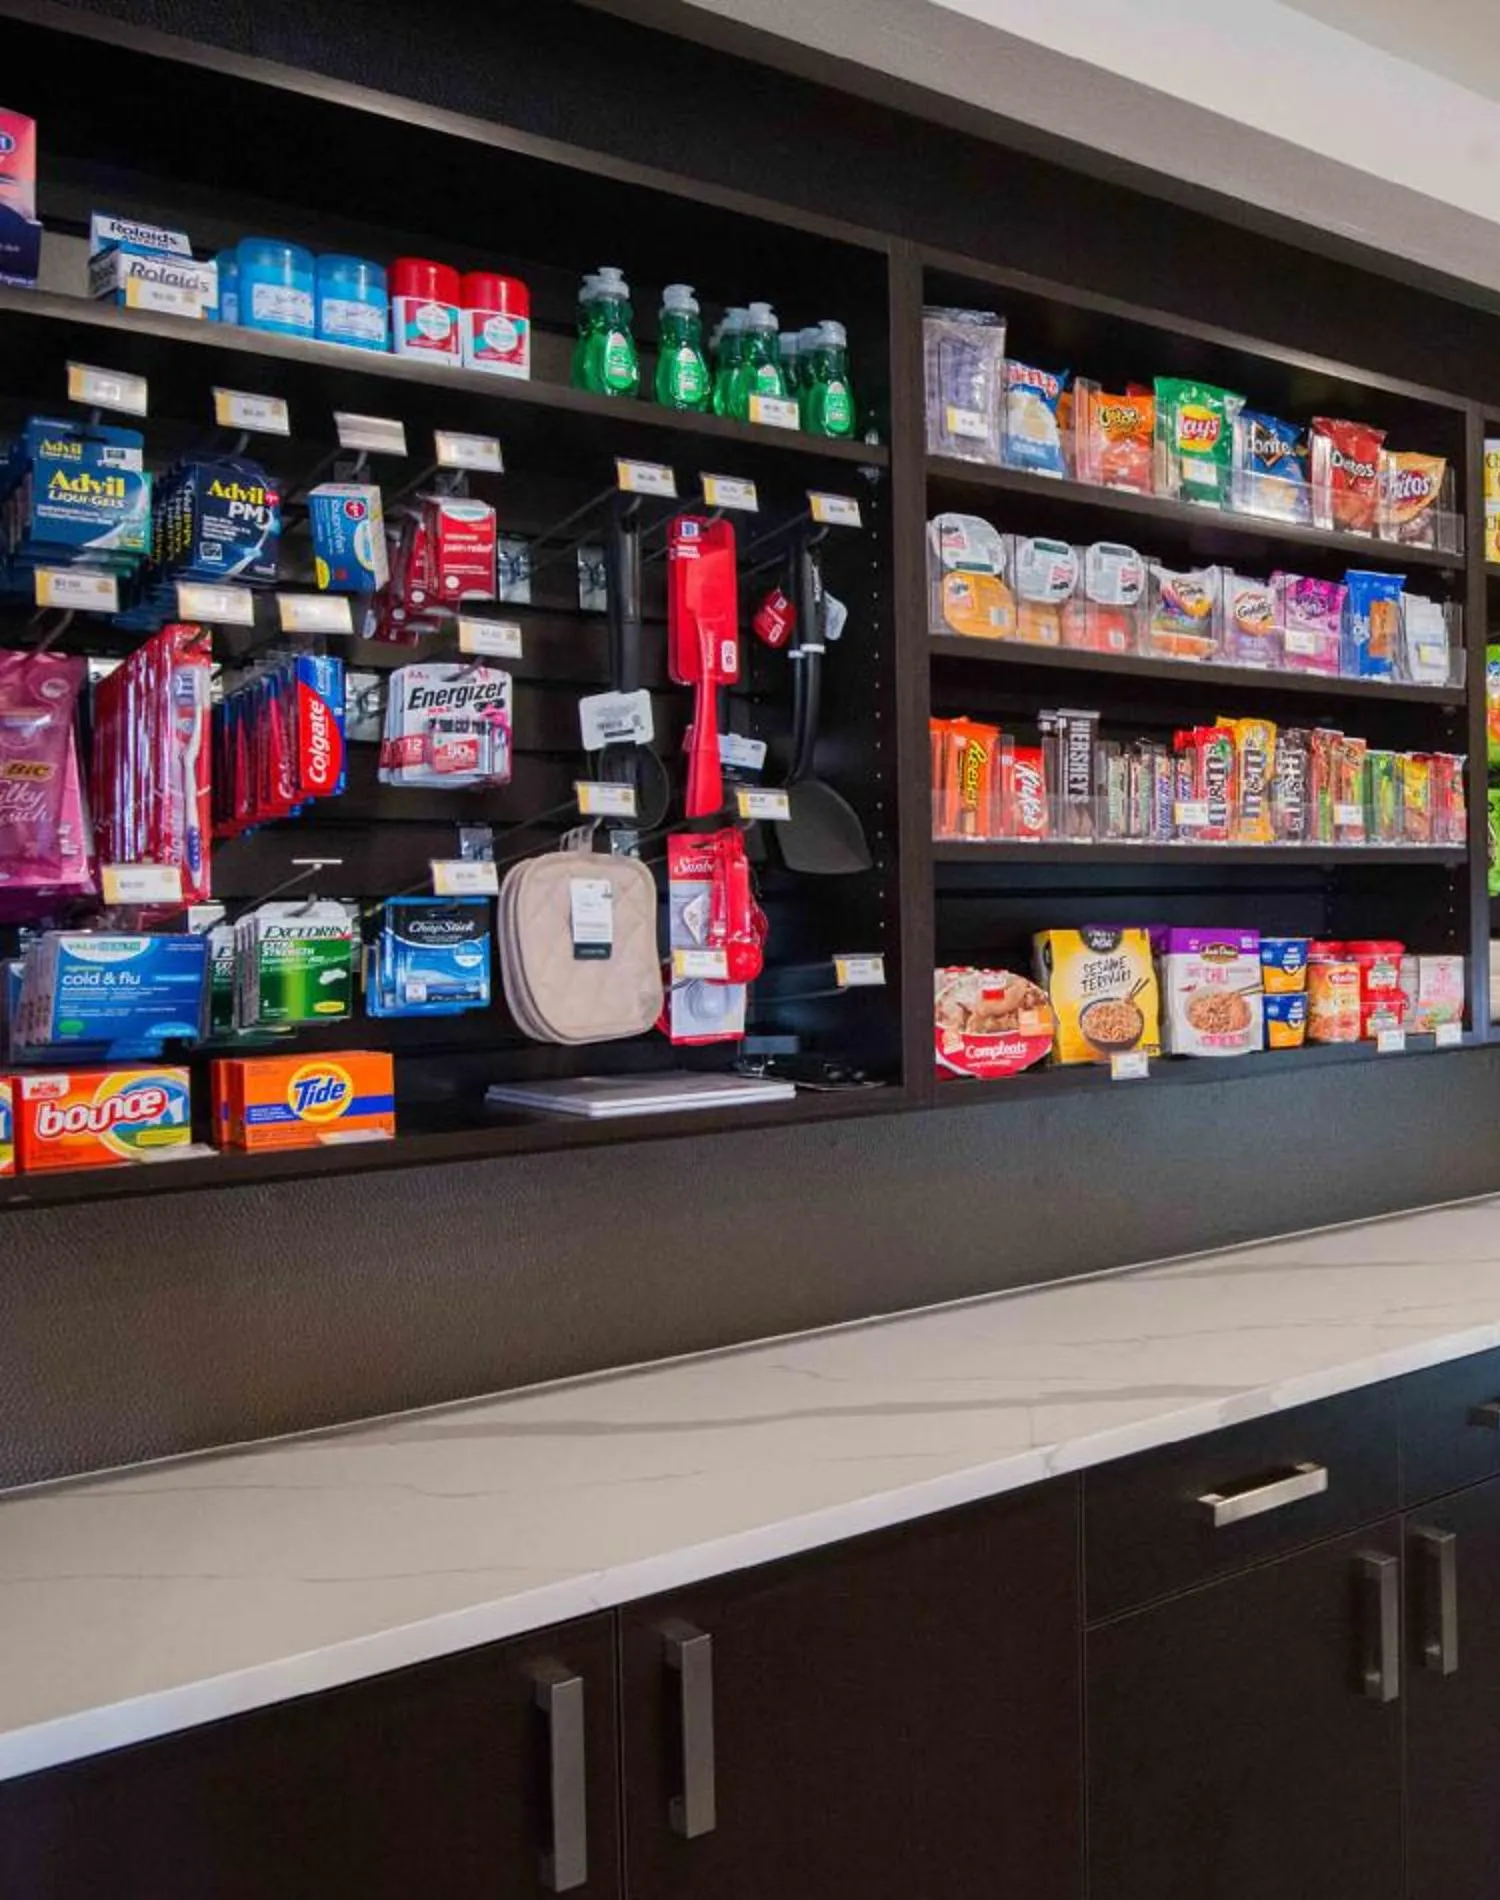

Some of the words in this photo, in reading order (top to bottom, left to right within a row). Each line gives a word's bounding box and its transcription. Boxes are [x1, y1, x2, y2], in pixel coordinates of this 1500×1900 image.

[109, 220, 181, 246] Rolaids
[129, 260, 210, 294] Rolaids
[1330, 450, 1376, 478] Doritos
[48, 469, 125, 498] Advil
[206, 479, 264, 507] Advil
[228, 500, 265, 522] PM
[407, 681, 507, 711] Energizer
[309, 698, 331, 784] Colgate
[8, 763, 50, 777] BIC
[0, 779, 45, 808] ilky
[673, 854, 716, 875] Sunb
[264, 925, 349, 939] EXCEDRIN
[62, 972, 100, 986] cold
[103, 971, 116, 986] &
[119, 971, 141, 986] flu
[965, 1040, 1028, 1059] Compleats
[294, 1077, 347, 1113] Tide
[39, 1090, 163, 1138] bounce
